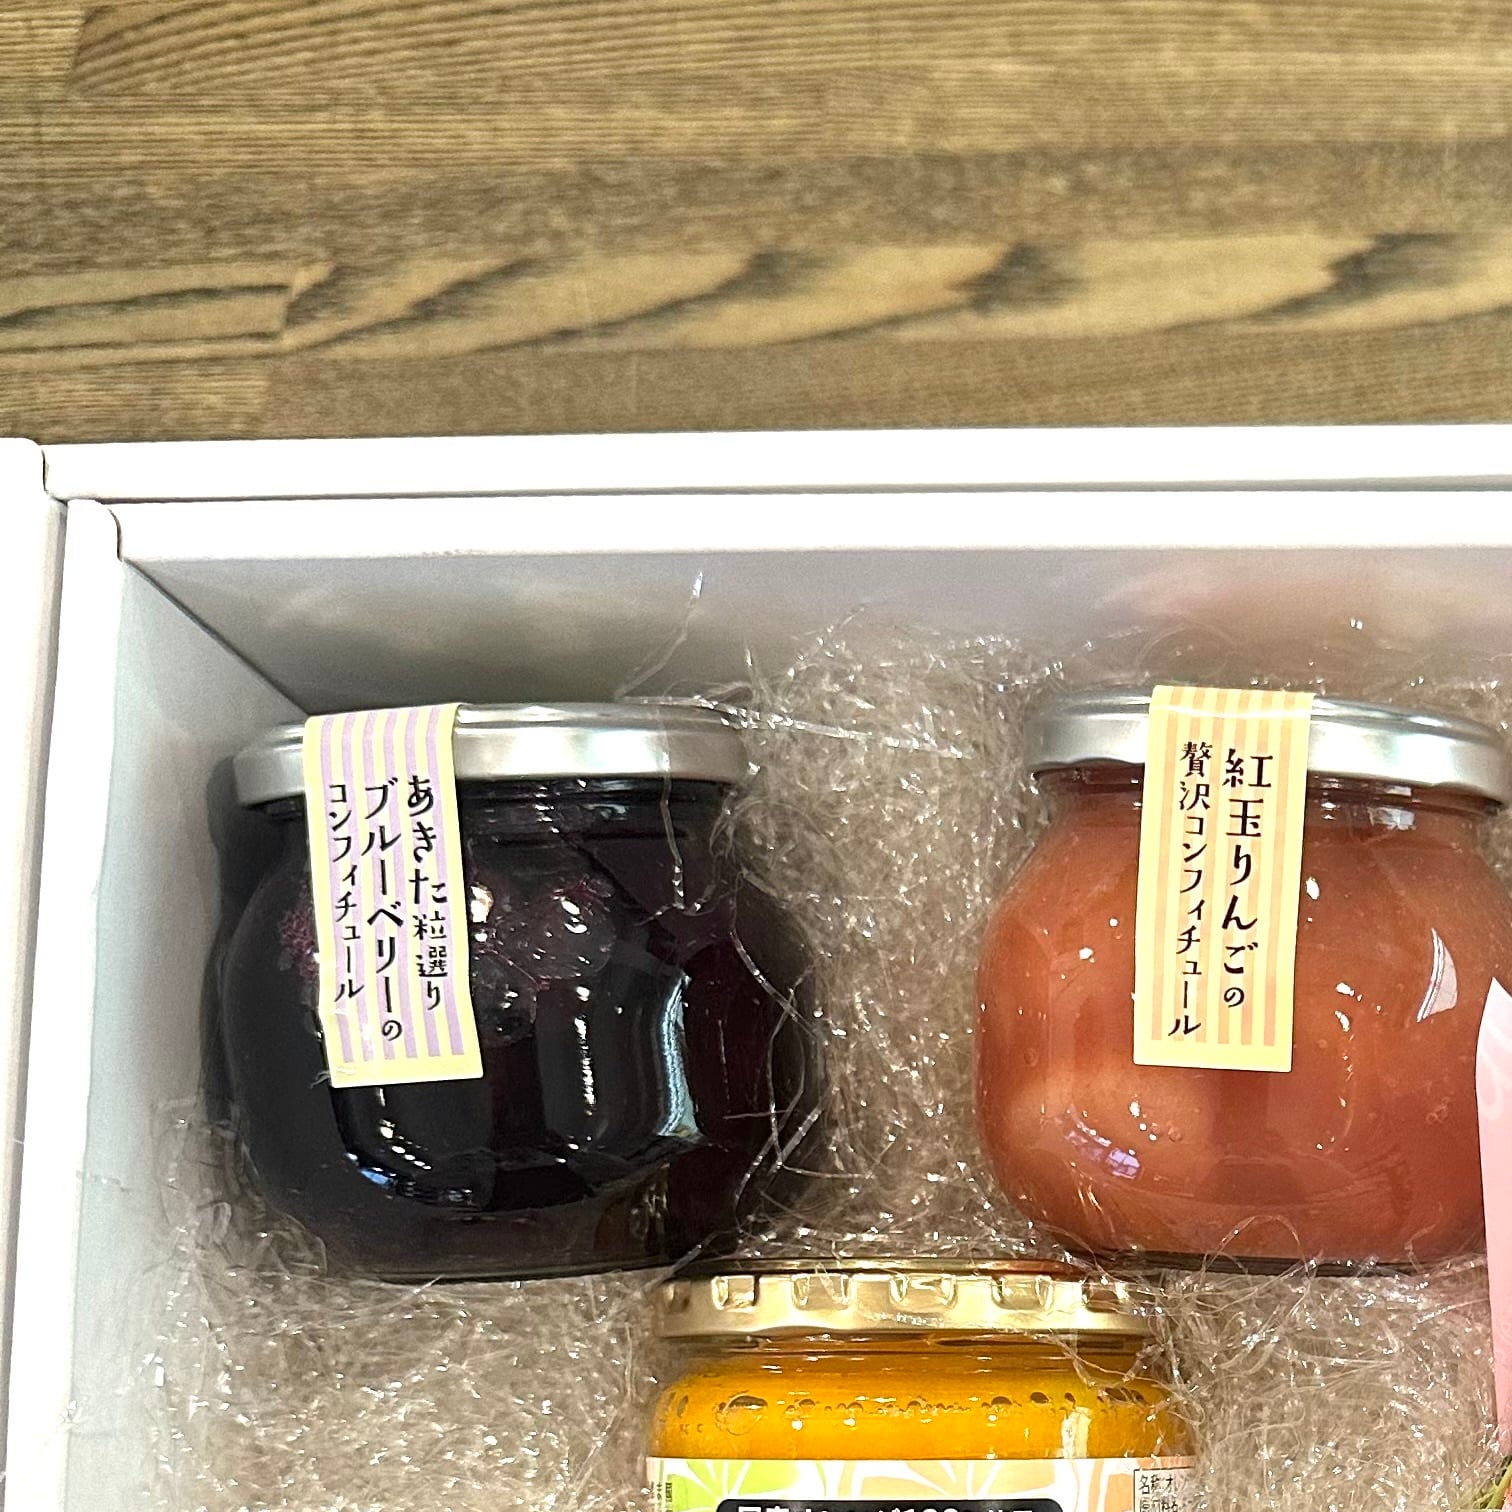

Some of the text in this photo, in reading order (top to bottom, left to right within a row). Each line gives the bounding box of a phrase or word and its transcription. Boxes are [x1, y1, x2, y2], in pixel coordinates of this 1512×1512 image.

[328, 784, 364, 1002] コンフィチュール
[361, 777, 403, 1042] ブルーベリーの
[407, 775, 448, 1010] あきた粒選り
[1168, 741, 1213, 1037] 贅沢コンフィチュール
[1222, 748, 1273, 1008] 紅玉りんごの
